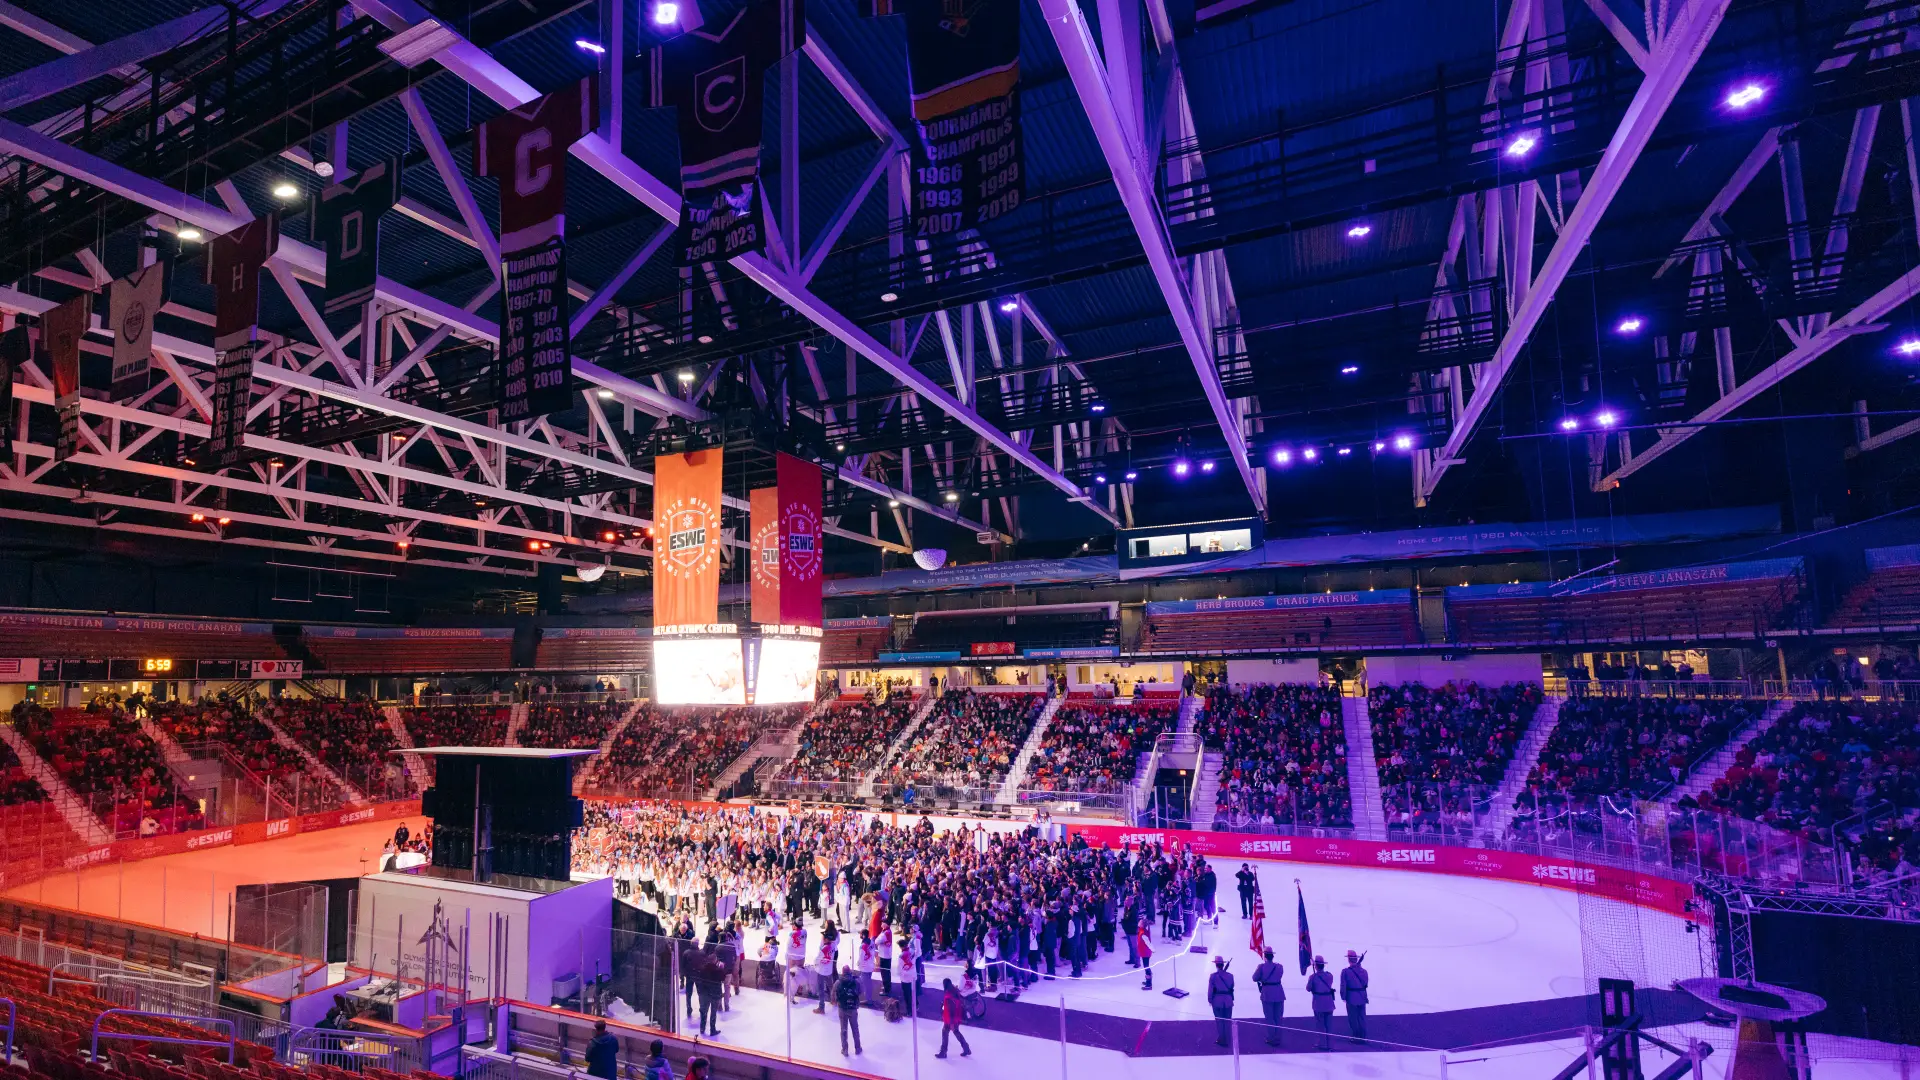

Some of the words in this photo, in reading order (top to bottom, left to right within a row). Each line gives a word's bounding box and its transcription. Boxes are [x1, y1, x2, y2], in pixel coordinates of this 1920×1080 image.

[703, 74, 737, 114] C
[921, 91, 1015, 140] TOURNAMENT
[926, 116, 1013, 160] CHAMPIONS
[514, 126, 553, 198] C
[917, 163, 963, 185] 1966
[977, 138, 1016, 174] 1991
[917, 188, 963, 210] 1993
[978, 162, 1019, 199] 1999
[917, 212, 963, 236] 2007
[977, 188, 1020, 223] 2019
[340, 210, 363, 260] D
[725, 223, 757, 252] 2023
[232, 263, 244, 293] H
[532, 347, 564, 367] 2005
[533, 368, 563, 389] 2010
[503, 398, 529, 417] 2024
[669, 528, 706, 551] ESWG
[789, 535, 814, 551] ESWG
[1473, 531, 1505, 540] 1980
[1618, 574, 1656, 587] STEVE
[1658, 567, 1728, 584] JANASZAK
[1195, 600, 1222, 610] HERB
[1224, 598, 1265, 609] BROOKS
[1276, 596, 1309, 606] CRAIG
[1311, 594, 1359, 605] PATRICK
[168, 621, 242, 632] MCCLANAHAN
[420, 628, 439, 637] BUZZ
[707, 624, 738, 634] CENTER
[146, 659, 172, 671] 6:59
[1444, 653, 1453, 661] 17
[253, 661, 260, 672] I
[276, 661, 301, 672] NY
[349, 807, 375, 822] ESWG
[199, 829, 232, 846] ESWG
[1131, 833, 1164, 845] ESWG
[1254, 840, 1291, 852] ESWG
[1315, 849, 1350, 857] Community
[1391, 850, 1436, 862] ESWG
[1463, 859, 1503, 869] Community
[1548, 865, 1596, 883] ESWG
